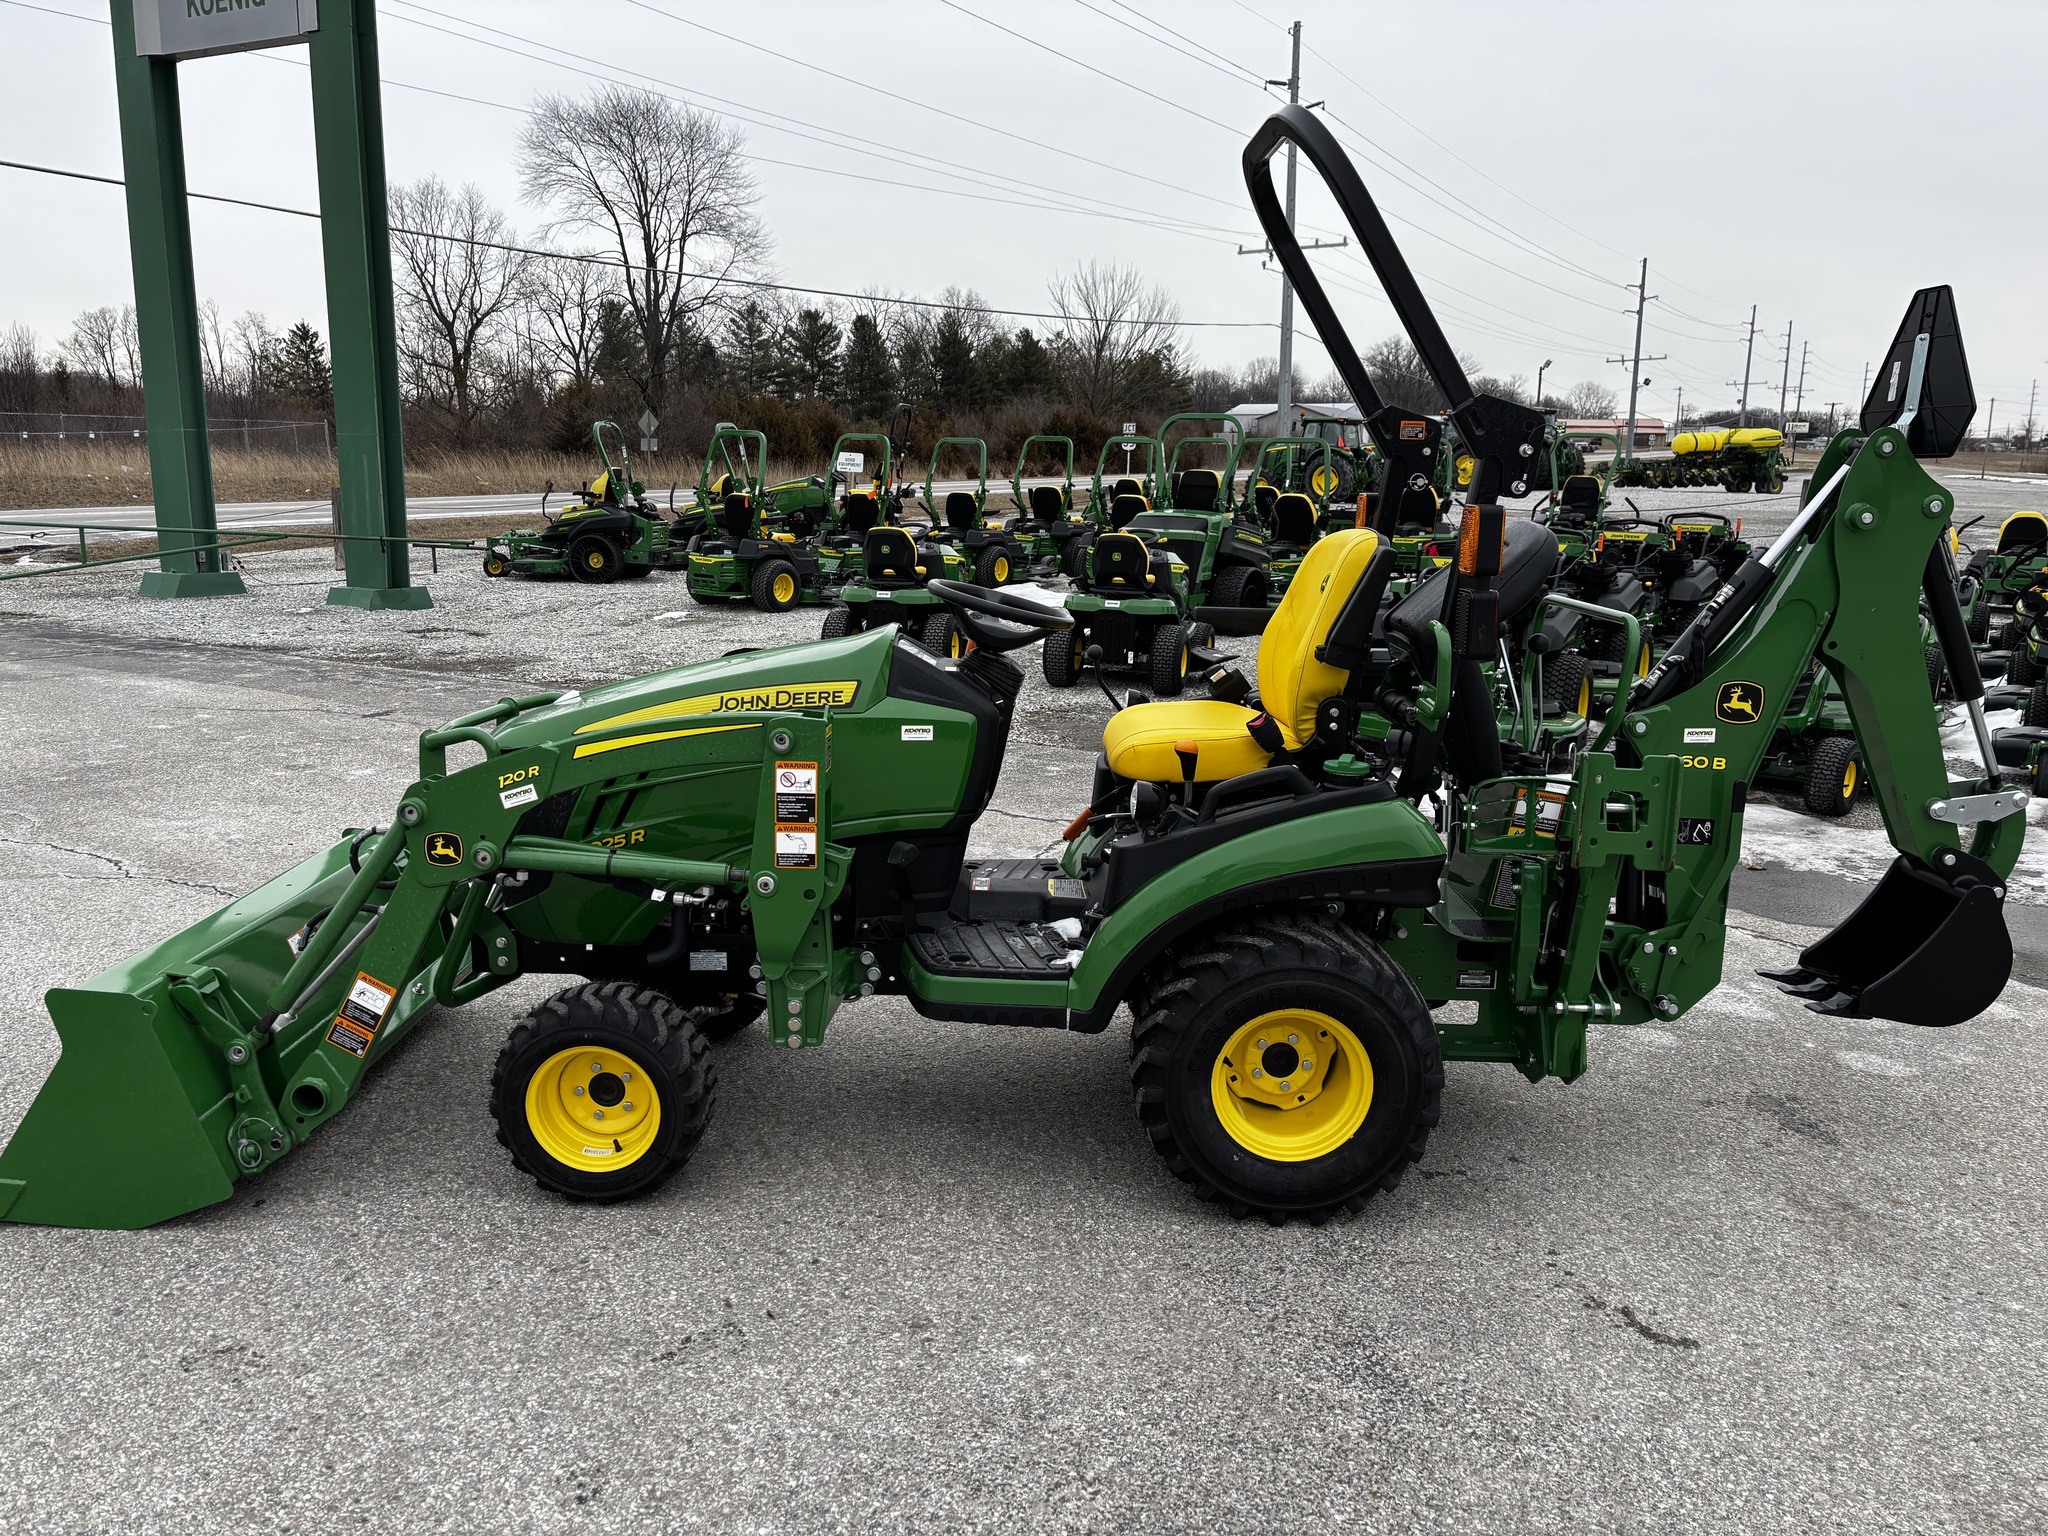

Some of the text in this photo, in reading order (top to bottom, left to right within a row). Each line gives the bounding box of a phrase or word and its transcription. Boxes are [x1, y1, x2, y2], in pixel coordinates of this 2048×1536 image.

[186, 0, 266, 18] KOE
[1124, 424, 1135, 432] JCT
[711, 690, 844, 712] JOHN DEERE
[1667, 754, 1727, 770] 60 B
[498, 765, 540, 789] 120 R
[783, 825, 815, 833] WARNING
[591, 829, 646, 849] 25 R
[367, 979, 392, 994] WARNING
[345, 1024, 369, 1038] WARNING
[1188, 987, 1285, 1074] CARLSTAR
